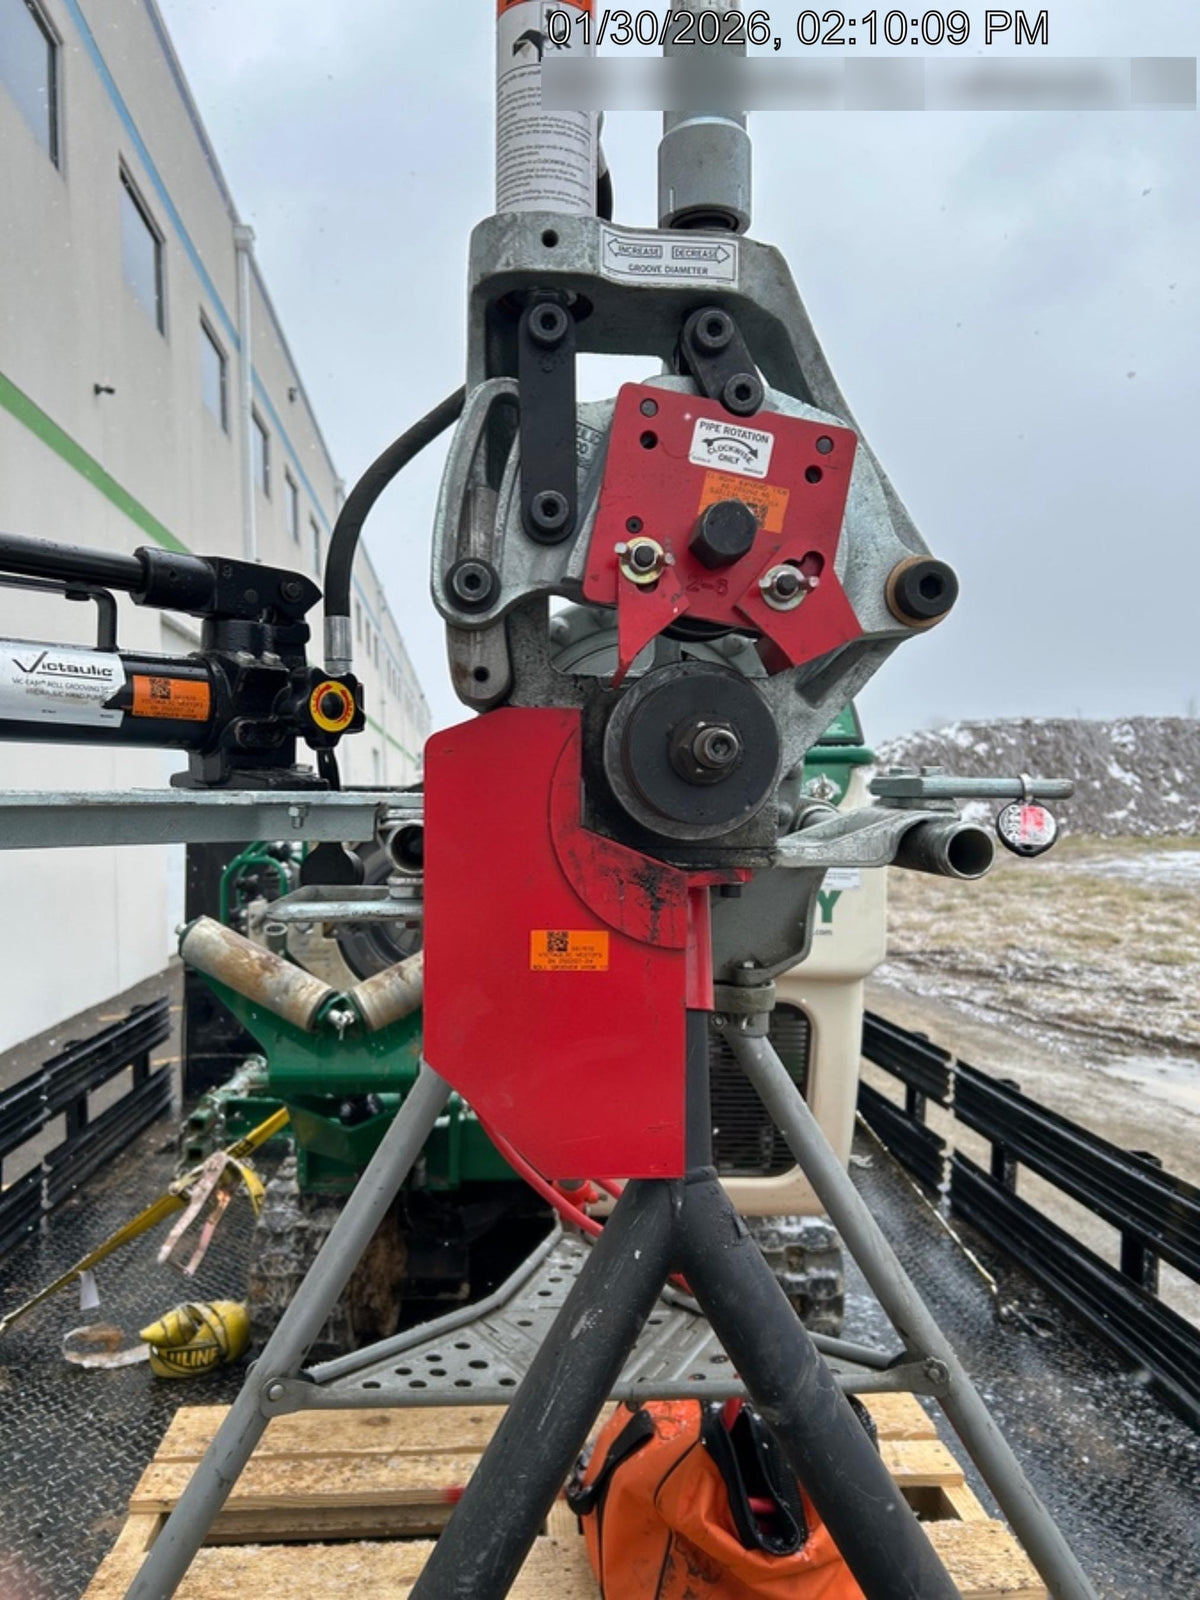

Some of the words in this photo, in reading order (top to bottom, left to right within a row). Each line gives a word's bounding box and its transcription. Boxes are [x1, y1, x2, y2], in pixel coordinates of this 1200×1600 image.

[618, 244, 659, 257] INCREASE
[675, 248, 717, 260] DECREASE
[628, 263, 662, 274] GROOVE
[664, 265, 708, 275] DIAMETER
[699, 420, 722, 433] PIPE
[722, 426, 770, 443] ROTATION
[706, 444, 755, 465] CLOCKWISE
[718, 454, 741, 465] ONLY
[12, 650, 114, 677] Victaulic
